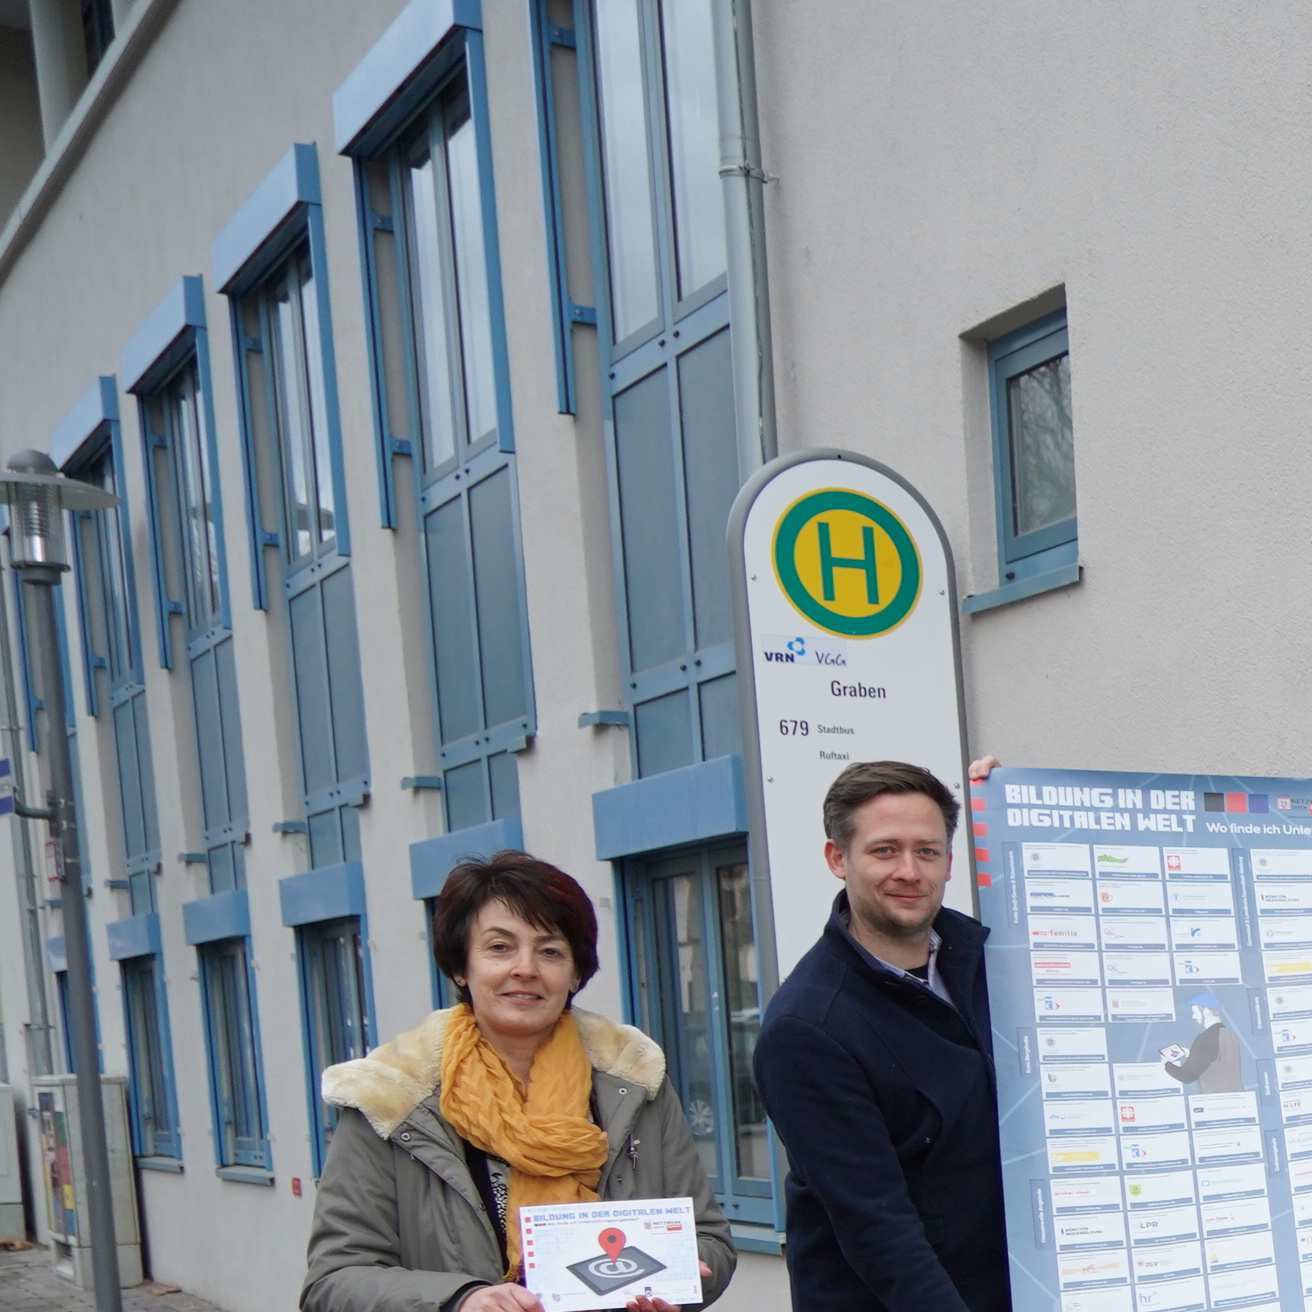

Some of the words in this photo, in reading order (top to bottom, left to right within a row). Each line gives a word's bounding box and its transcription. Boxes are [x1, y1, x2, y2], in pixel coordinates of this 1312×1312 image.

[817, 522, 879, 604] H
[764, 651, 795, 663] VRN
[830, 680, 887, 700] Graben
[779, 719, 809, 737] 679
[817, 724, 855, 735] Stadtbus
[819, 750, 850, 761] Ruftaxi
[1005, 784, 1113, 808] BILDUNG
[1118, 788, 1143, 809] IN
[1150, 790, 1196, 811] DER
[1007, 808, 1131, 831] DIGITALEN
[1137, 814, 1196, 832] WELT
[1206, 822, 1228, 834] Wo
[1229, 822, 1261, 834] finde
[1263, 823, 1281, 835] ich
[533, 1213, 576, 1222] BILDUNG
[592, 1210, 610, 1218] DER
[613, 1208, 662, 1217] DIGITALEN
[665, 1206, 691, 1215] WELT
